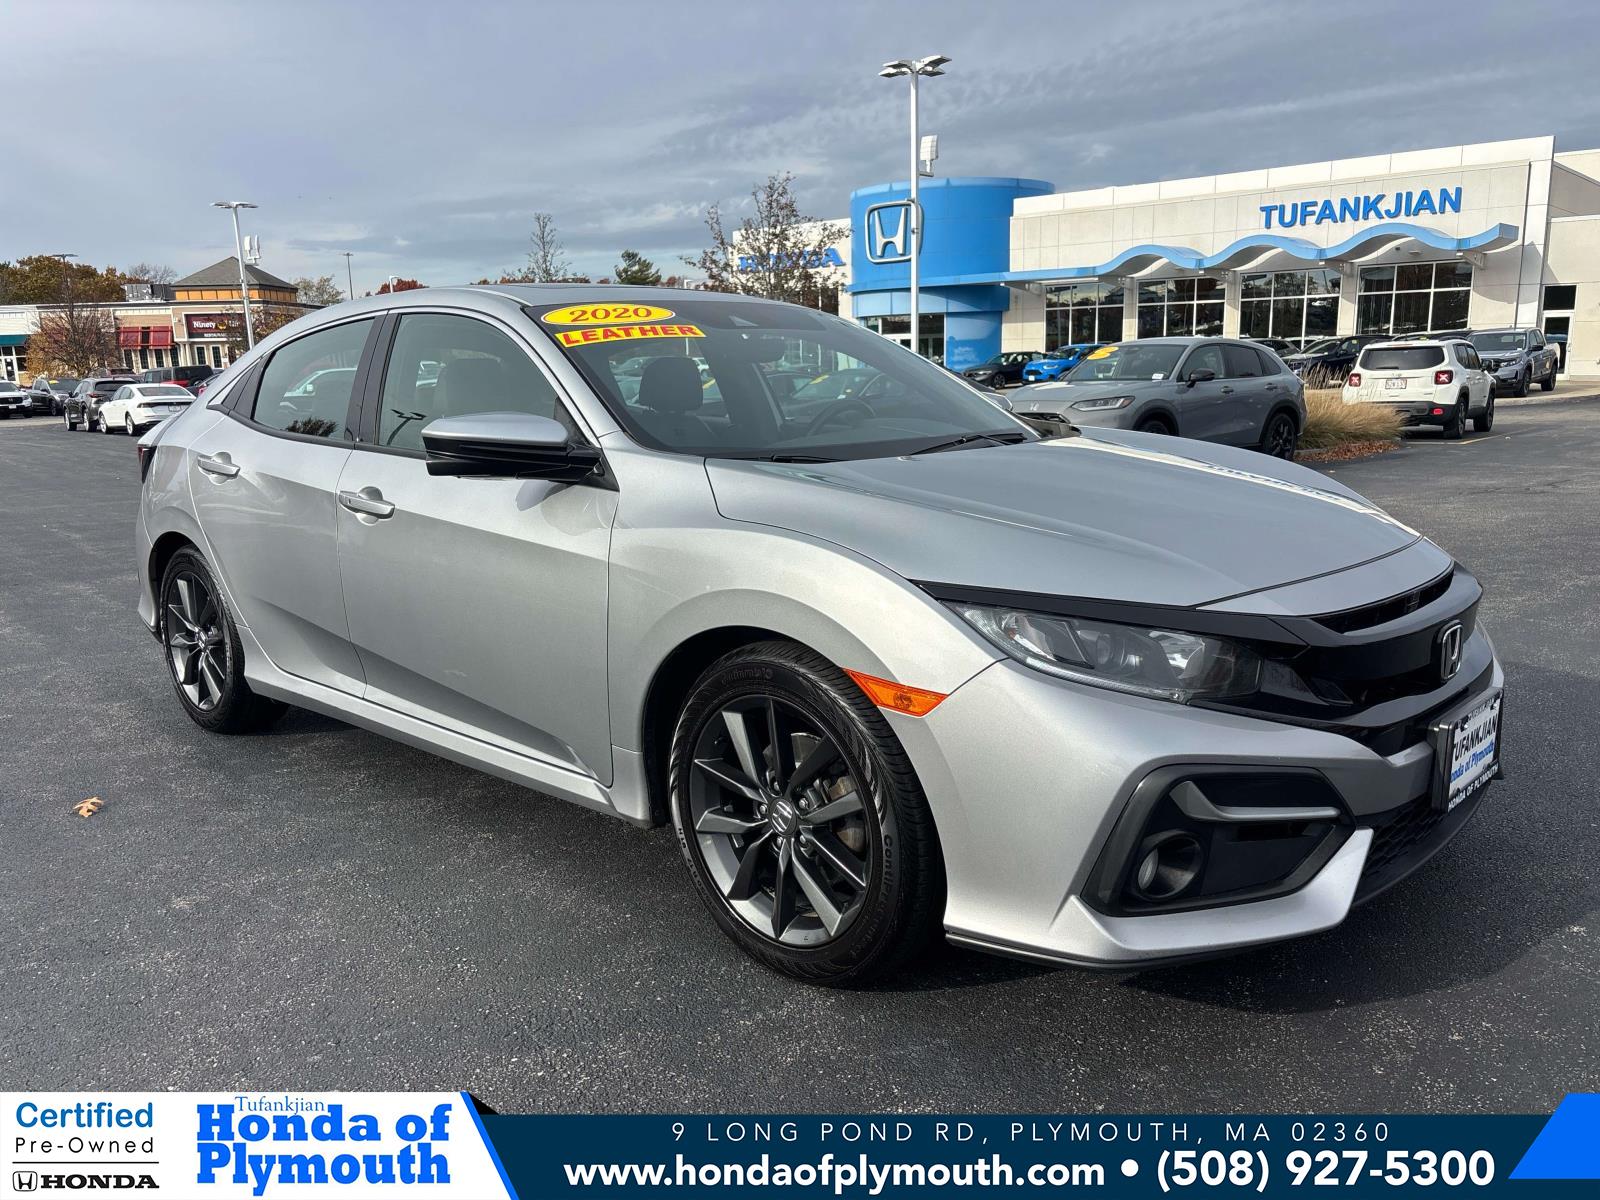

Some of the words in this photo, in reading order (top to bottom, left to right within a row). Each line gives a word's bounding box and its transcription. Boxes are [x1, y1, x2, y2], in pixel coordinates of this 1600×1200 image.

[1260, 186, 1463, 229] TUFANKJIAN
[192, 320, 216, 329] Ninety
[569, 307, 653, 323] 2020
[562, 325, 699, 346] LEATHER
[1454, 713, 1498, 762] UFANKJIAN
